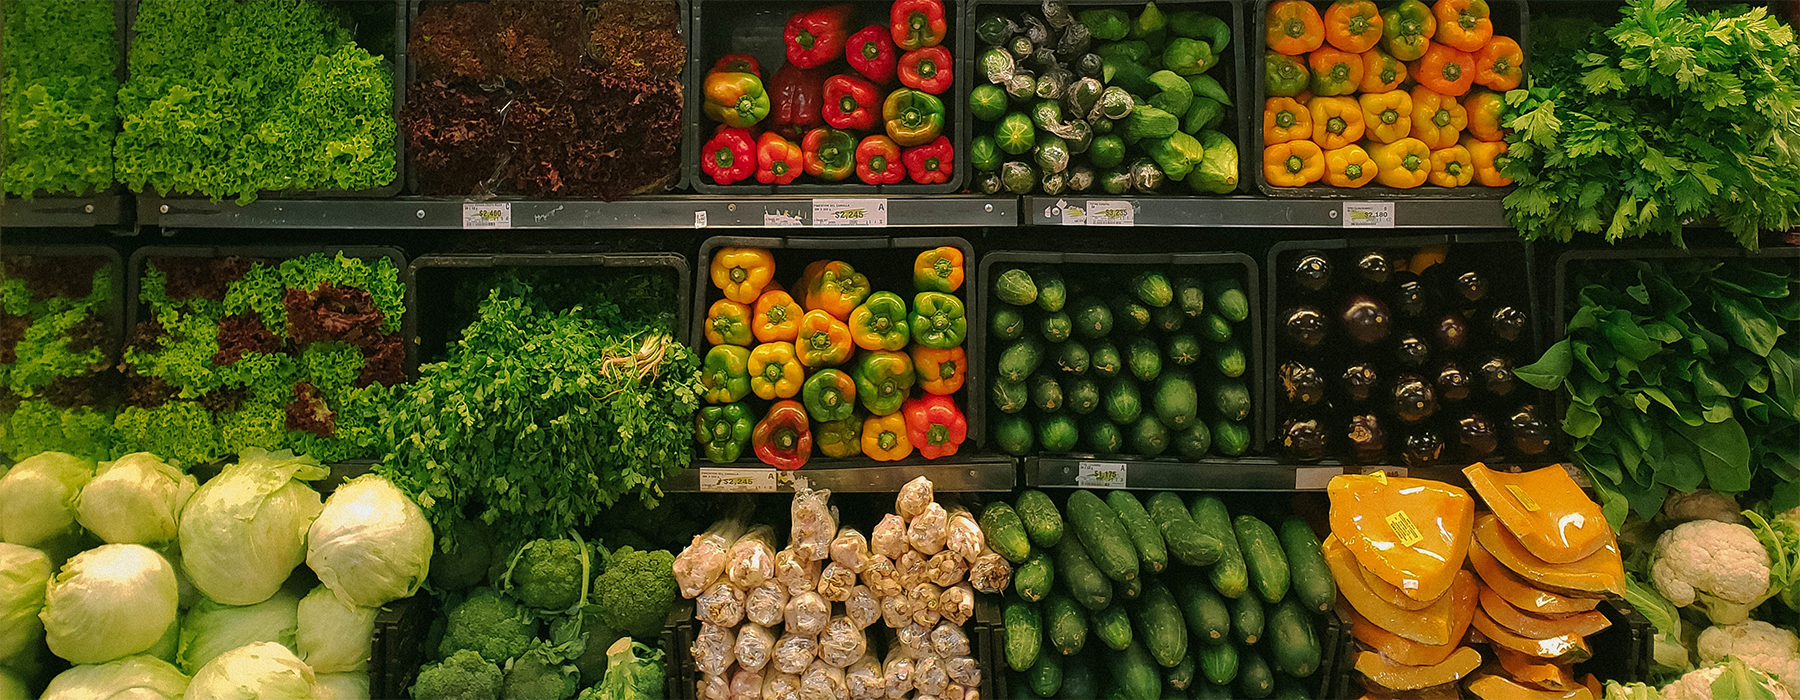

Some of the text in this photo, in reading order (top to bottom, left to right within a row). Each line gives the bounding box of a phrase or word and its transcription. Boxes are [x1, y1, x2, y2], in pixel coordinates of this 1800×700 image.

[878, 203, 885, 211] A
[834, 210, 864, 219] $2,245
[1120, 464, 1125, 472] A
